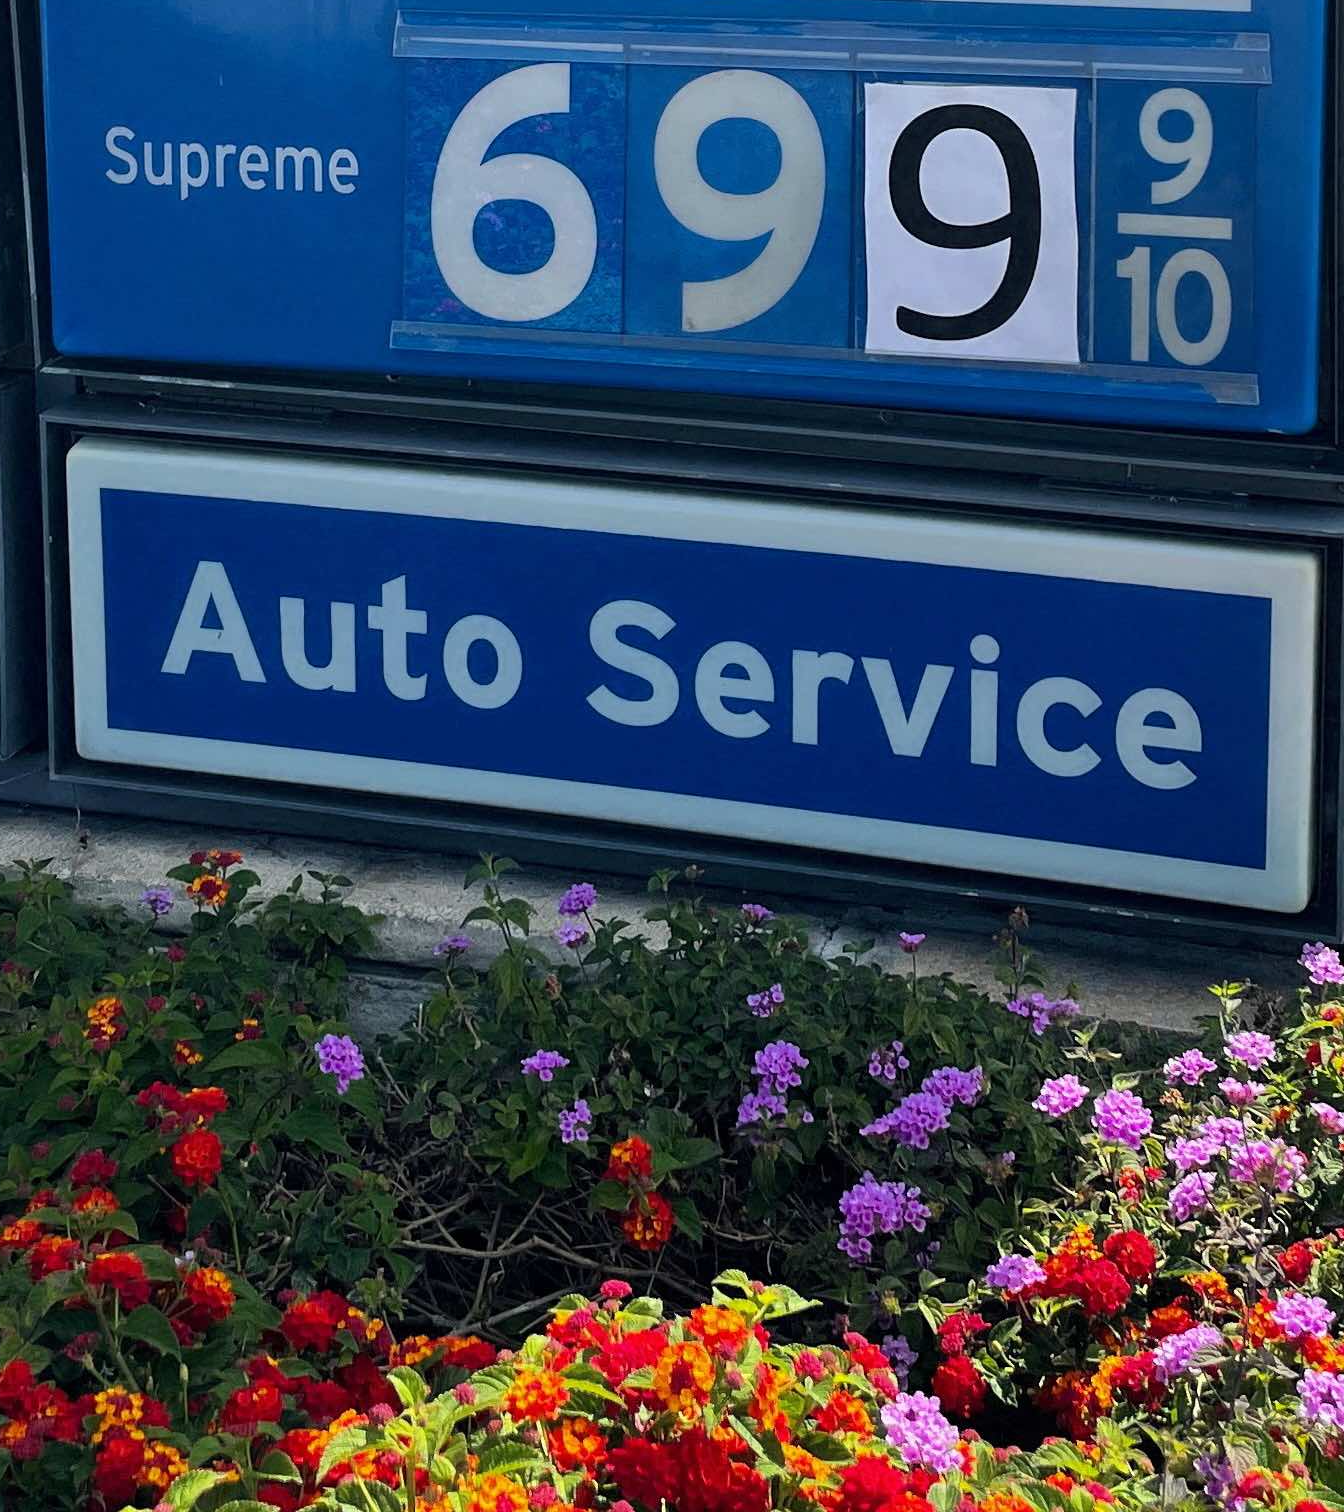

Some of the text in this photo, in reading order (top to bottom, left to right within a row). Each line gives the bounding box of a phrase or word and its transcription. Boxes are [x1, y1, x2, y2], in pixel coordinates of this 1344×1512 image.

[105, 126, 359, 201] Supreme
[160, 560, 1203, 792] Auto Service
